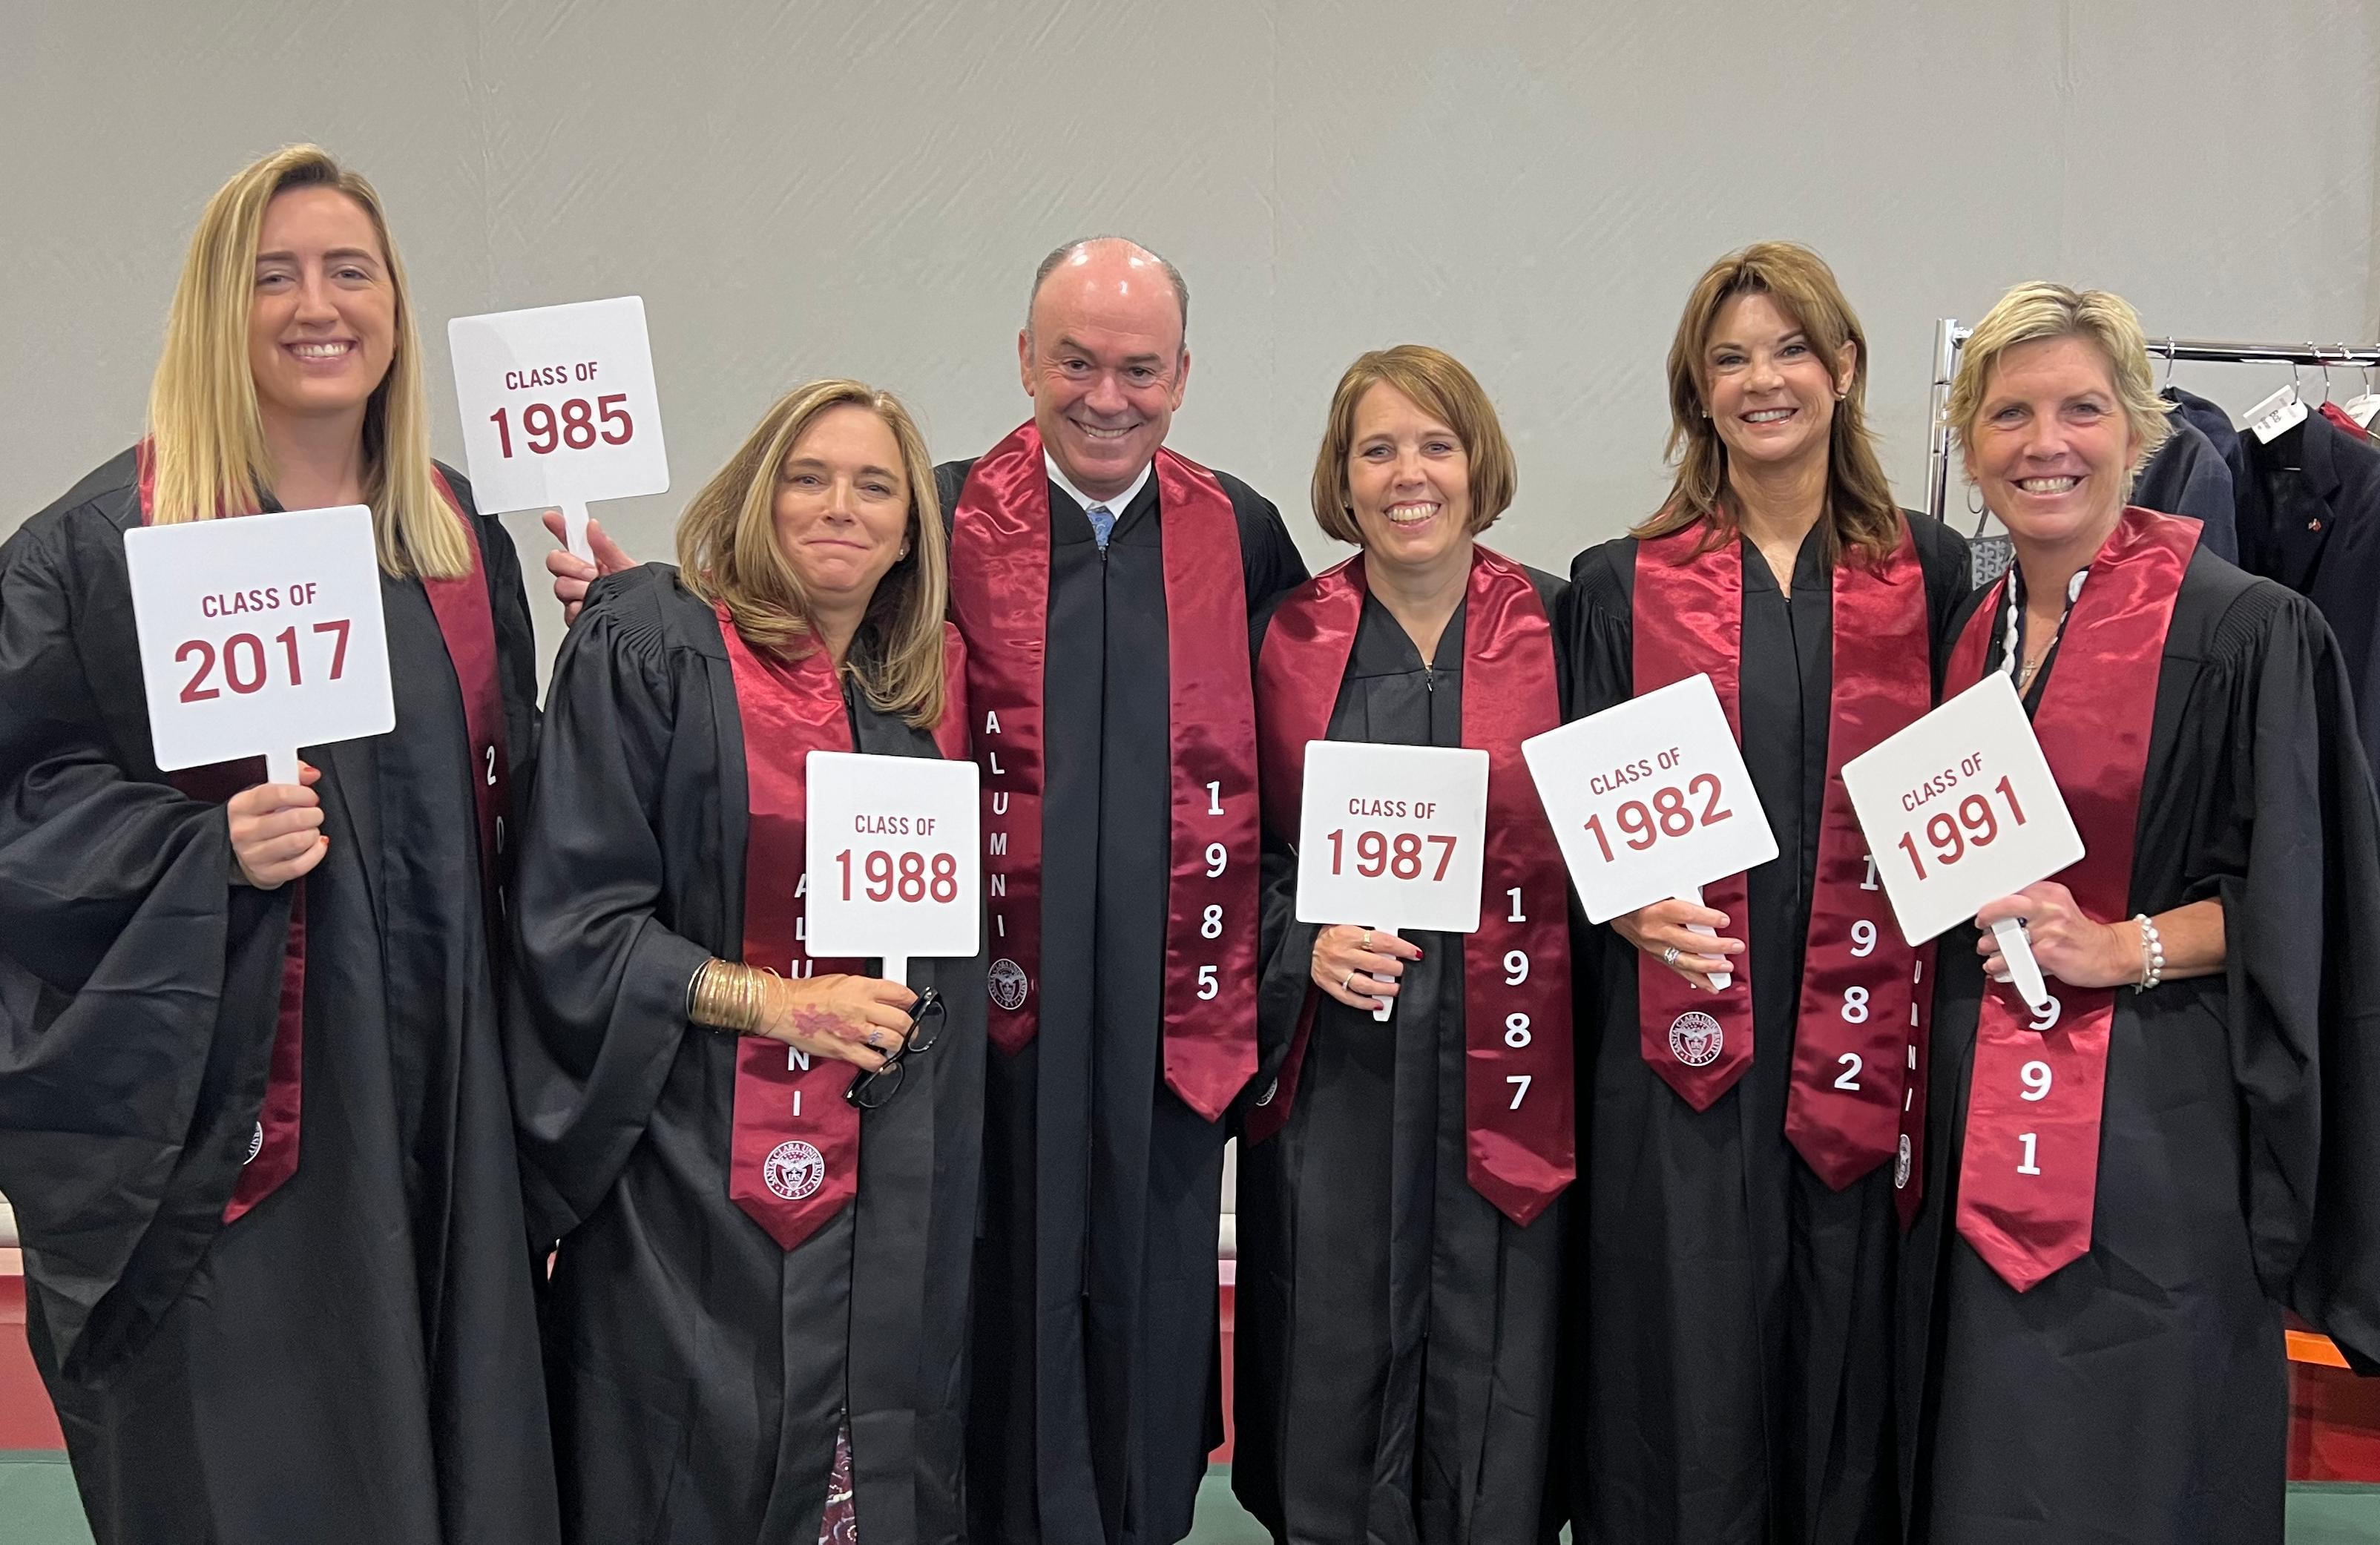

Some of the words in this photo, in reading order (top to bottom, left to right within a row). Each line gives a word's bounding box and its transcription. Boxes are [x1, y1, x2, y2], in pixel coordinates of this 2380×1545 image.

[506, 365, 568, 390] CLASS
[575, 361, 598, 382] OF
[490, 393, 634, 459] 1985
[202, 587, 280, 618] CLASS
[289, 582, 317, 606] OF
[175, 619, 350, 704] 2017
[1349, 798, 1407, 818] CLASS
[1414, 802, 1436, 820] OF
[1590, 759, 1652, 795] CLASS
[1657, 747, 1680, 770] OF
[1901, 768, 1957, 812] CLASS
[1961, 751, 1982, 777] OF
[486, 745, 504, 916] 201
[855, 814, 909, 835] CLASS
[916, 817, 936, 836] OF
[985, 711, 1009, 937] ALUMNI
[1327, 828, 1457, 882] 1987
[1583, 773, 1733, 863] 1982
[1898, 775, 2026, 881] 1991
[835, 849, 958, 904] 1988
[1197, 781, 1227, 1001] 1985
[787, 873, 814, 1116] ALUNI
[1503, 887, 1532, 1110] 1987
[1834, 854, 1878, 1090] 1982
[2016, 995, 2061, 1176] 991
